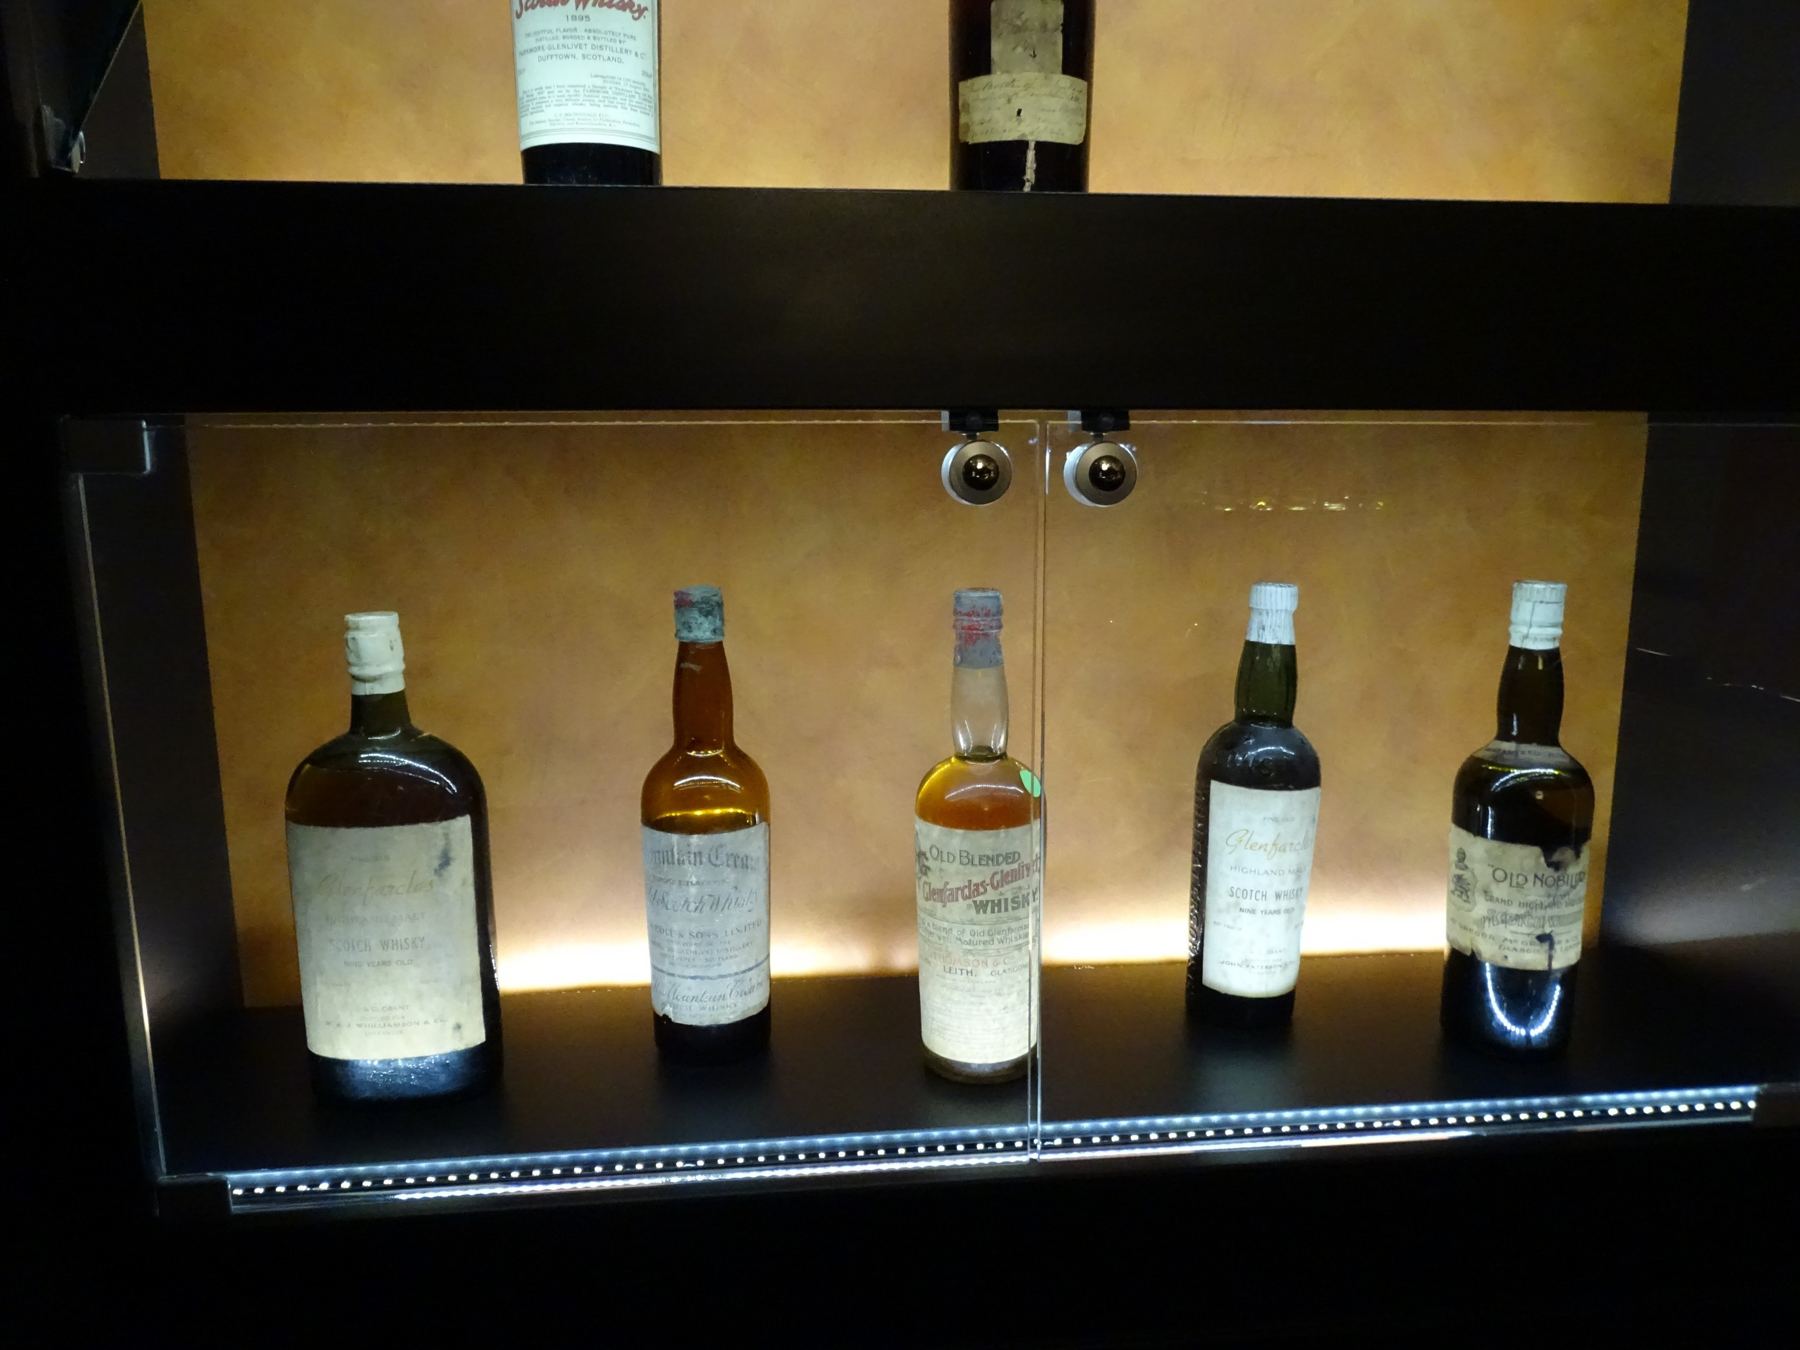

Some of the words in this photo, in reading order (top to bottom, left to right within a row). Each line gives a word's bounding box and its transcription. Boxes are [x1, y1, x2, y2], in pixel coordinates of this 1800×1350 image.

[547, 43, 588, 51] GLENLIVET
[591, 44, 633, 56] DISTILLERY
[959, 849, 1021, 867] BLENDED
[1230, 864, 1285, 877] HIGHLAND
[1229, 886, 1267, 902] SCOTCH
[381, 935, 425, 952] WHISKY
